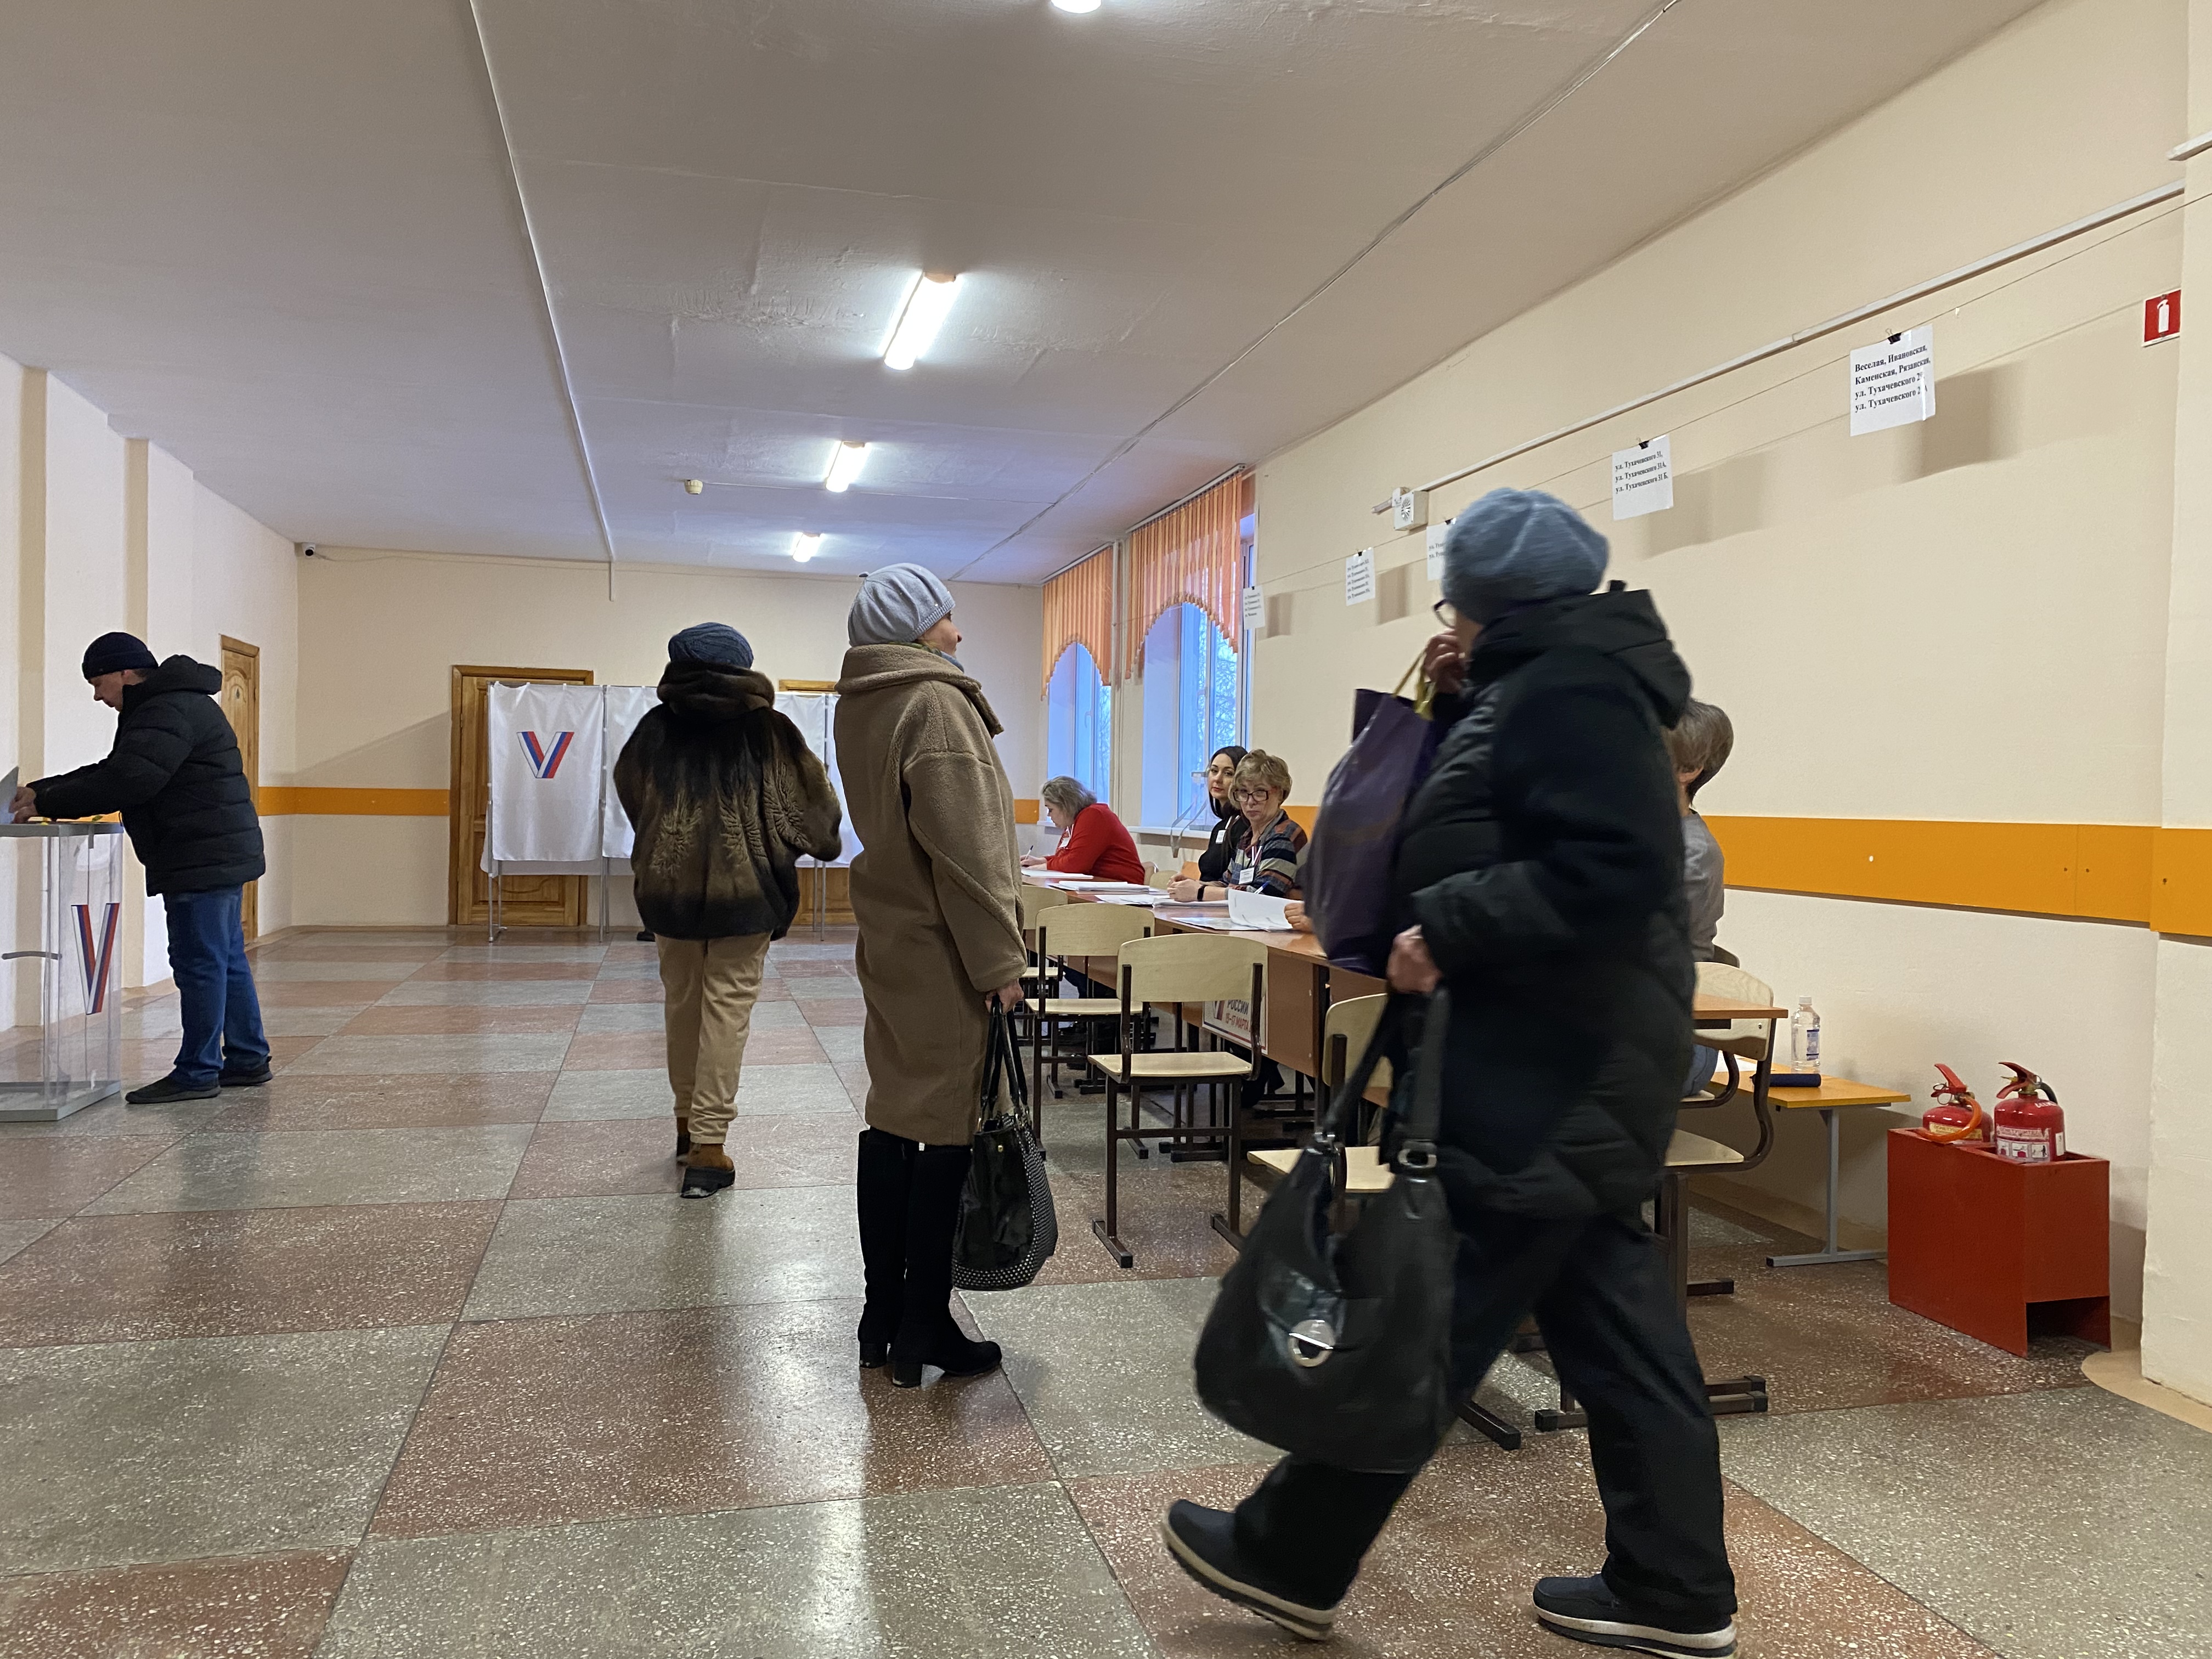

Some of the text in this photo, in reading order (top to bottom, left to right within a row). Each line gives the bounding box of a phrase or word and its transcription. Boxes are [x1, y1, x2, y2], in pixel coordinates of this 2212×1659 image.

[1855, 358, 1887, 373] Веселая,
[1855, 357, 1931, 385] Каменская, Рязанская,
[1855, 391, 1866, 400] ул.
[1868, 376, 1916, 396] Тухачевского
[1855, 404, 1866, 413] ул.
[1868, 390, 1916, 409] Тухачевского
[1227, 1000, 1249, 1015] РОССИИ
